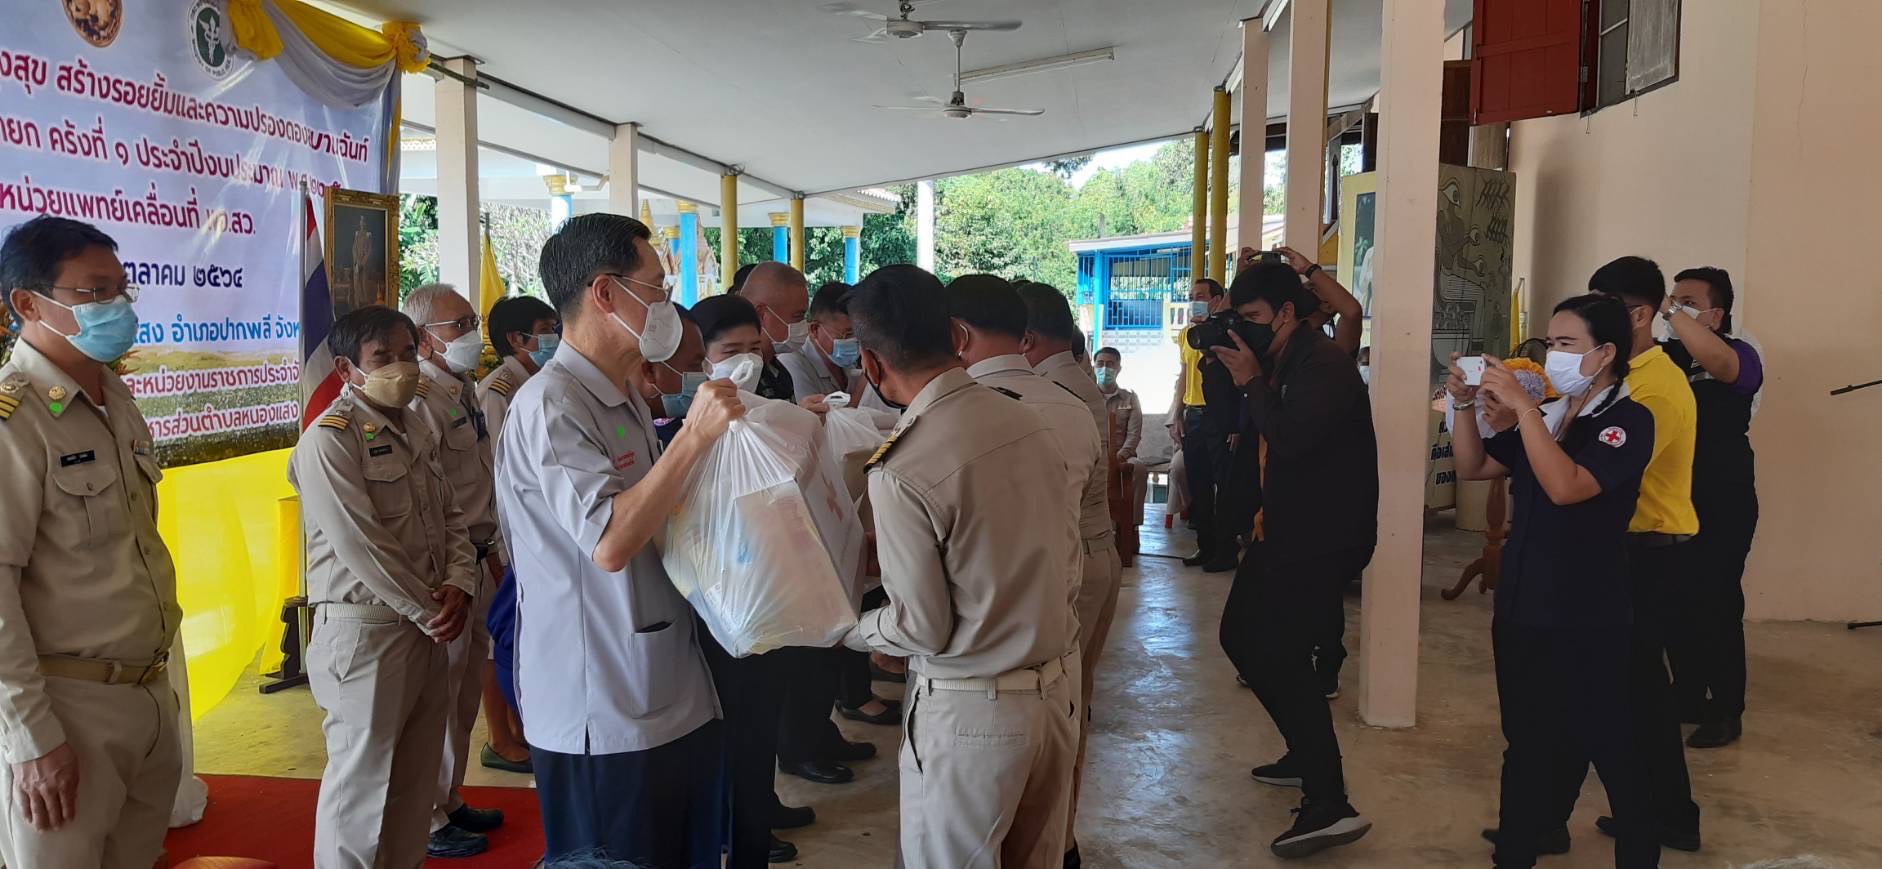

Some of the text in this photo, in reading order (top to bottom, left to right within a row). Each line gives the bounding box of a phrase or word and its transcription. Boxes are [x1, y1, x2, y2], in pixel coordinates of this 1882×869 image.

[49, 116, 108, 160] ครั้งที่
[115, 141, 129, 166] ๑
[193, 264, 243, 288] ๒๕๖๔
[171, 313, 271, 343] อำเภอปากพลี
